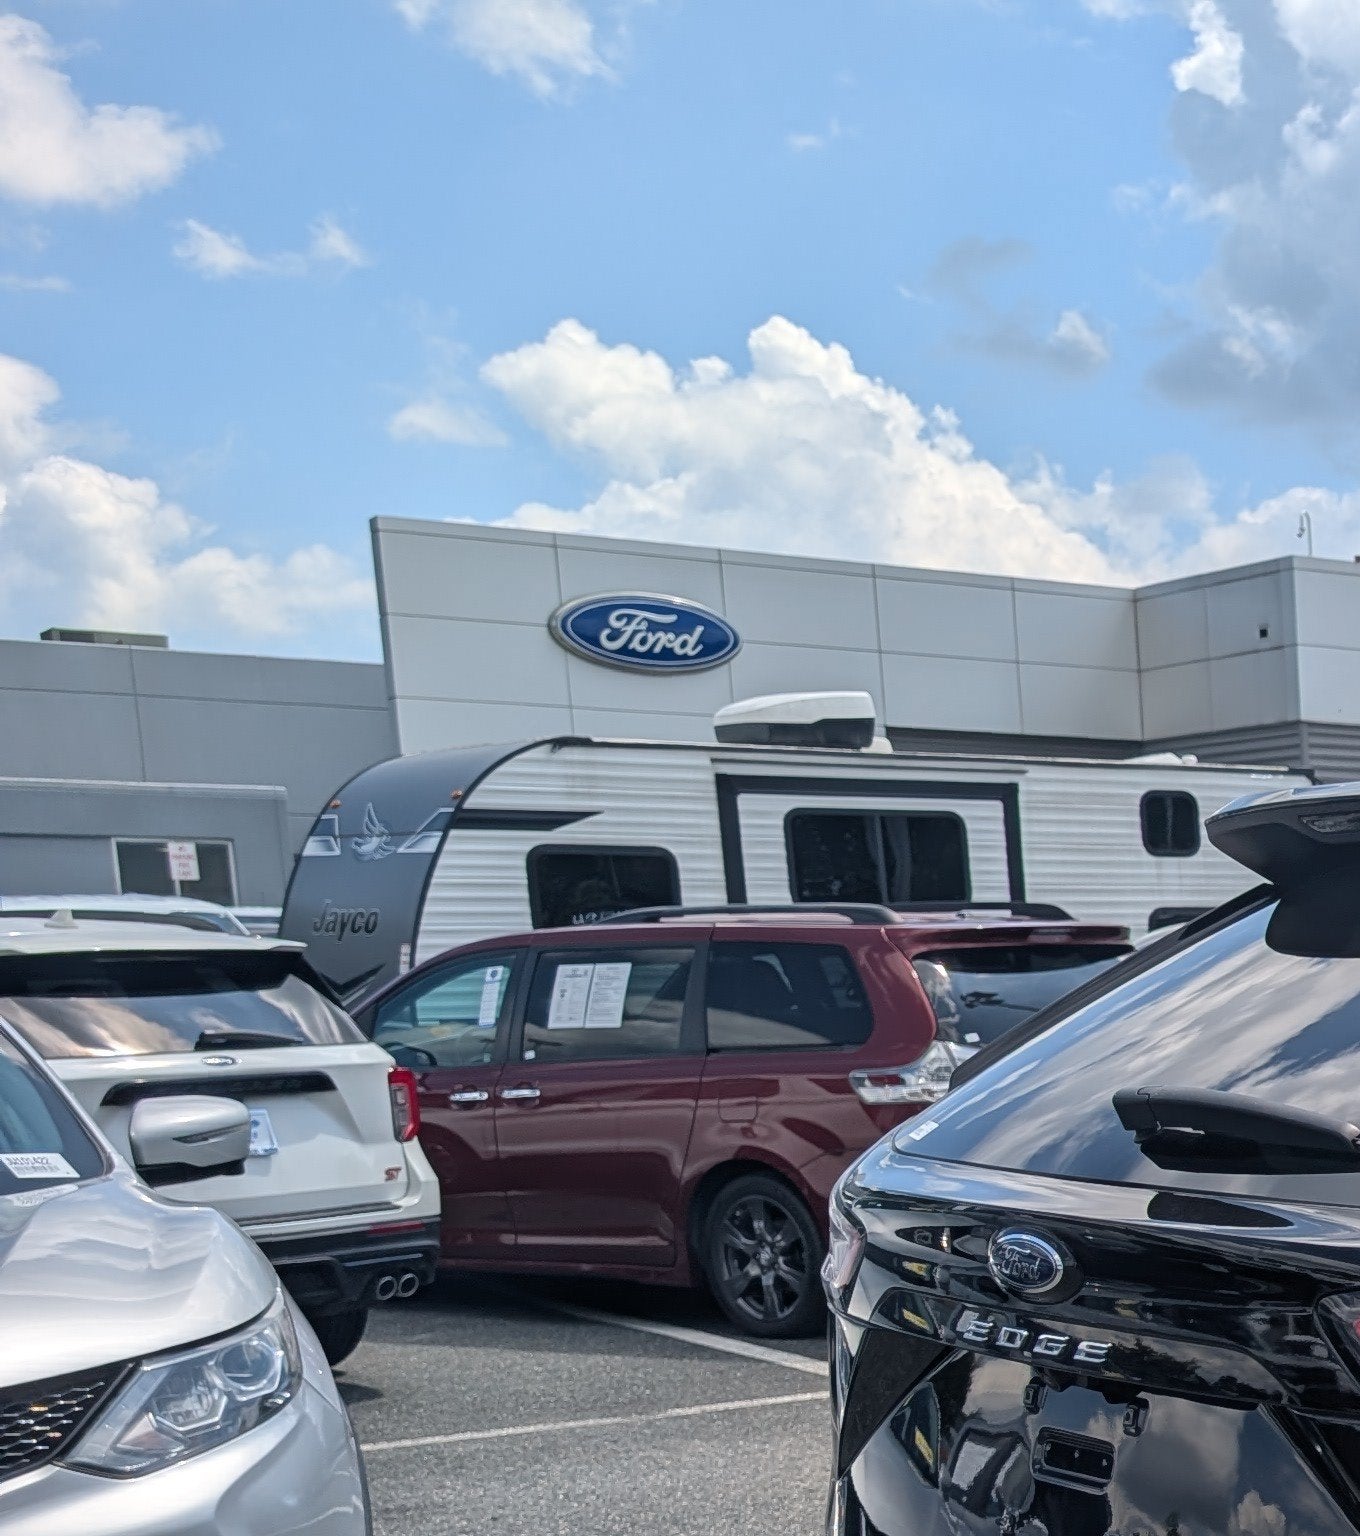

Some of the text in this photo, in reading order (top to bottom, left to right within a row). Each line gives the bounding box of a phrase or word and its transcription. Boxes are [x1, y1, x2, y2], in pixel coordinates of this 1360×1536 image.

[600, 608, 704, 657] Ford
[312, 899, 380, 944] Jayco
[1000, 1244, 1042, 1281] Ford
[962, 1319, 1114, 1363] EDGE
